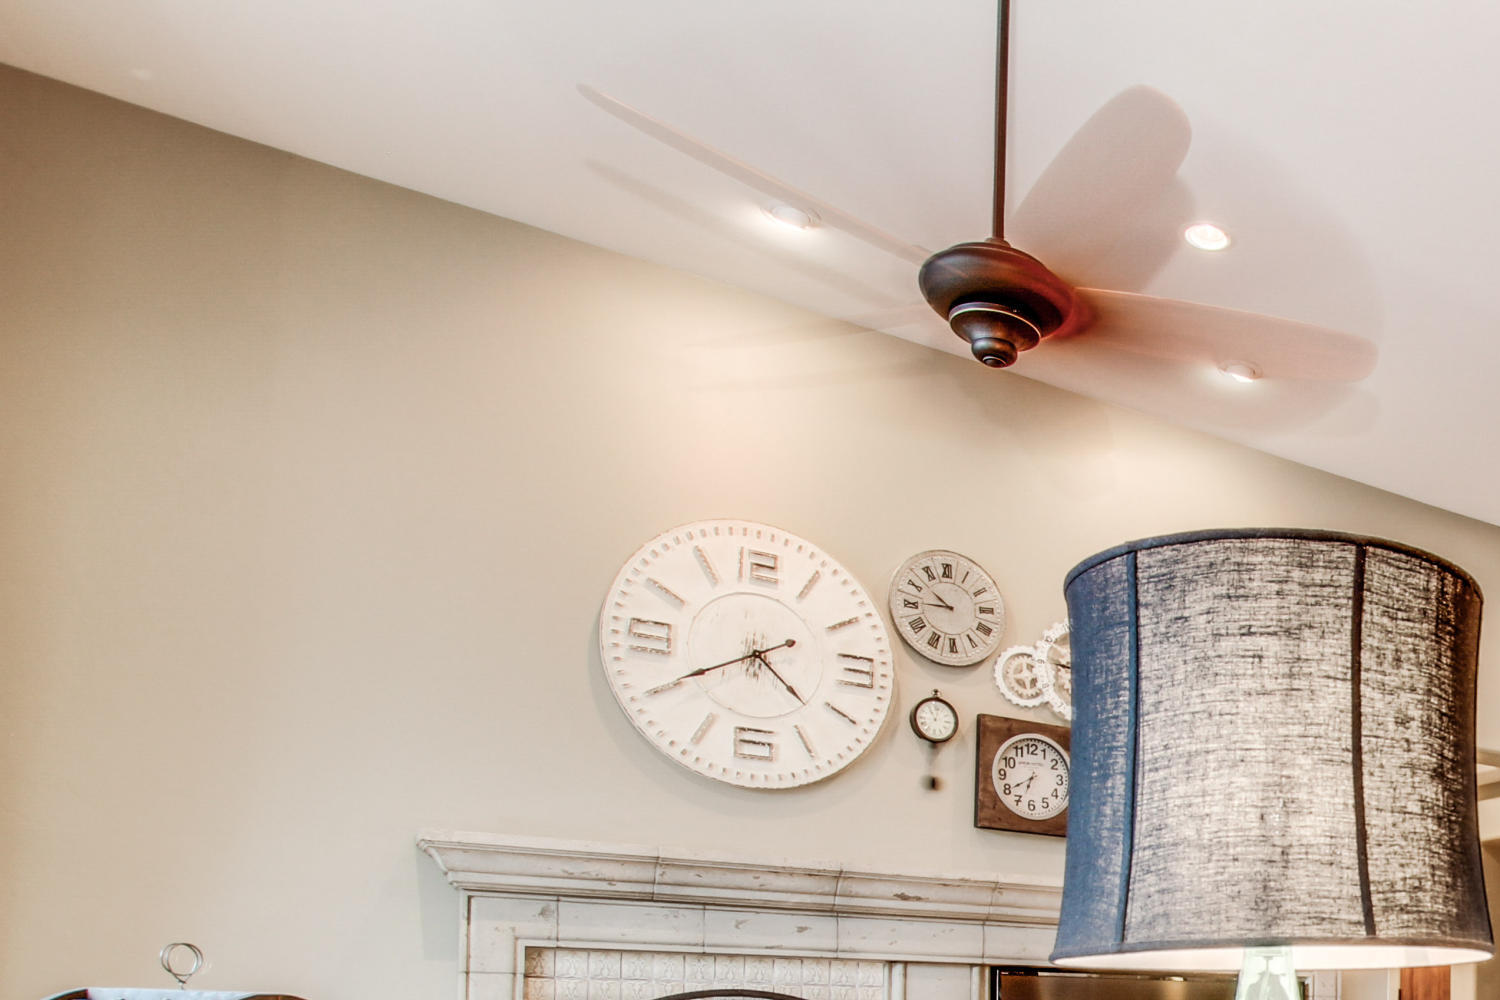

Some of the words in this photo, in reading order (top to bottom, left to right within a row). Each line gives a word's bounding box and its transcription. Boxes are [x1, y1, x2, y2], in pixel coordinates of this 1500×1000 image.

[737, 546, 779, 584] 12
[628, 617, 673, 656] 9
[837, 653, 874, 689] 3
[733, 725, 776, 762] 6
[1024, 743, 1038, 755] 12
[1013, 745, 1023, 758] 11
[1040, 748, 1046, 760] 1
[1002, 756, 1016, 769] 10
[1050, 758, 1058, 771] 2
[998, 768, 1006, 780] 9
[1056, 774, 1064, 786] 3
[1003, 783, 1011, 795] 8
[1051, 788, 1059, 799] 4
[1014, 794, 1022, 806] 7
[1027, 800, 1036, 811] 6
[1041, 797, 1049, 809] 5
